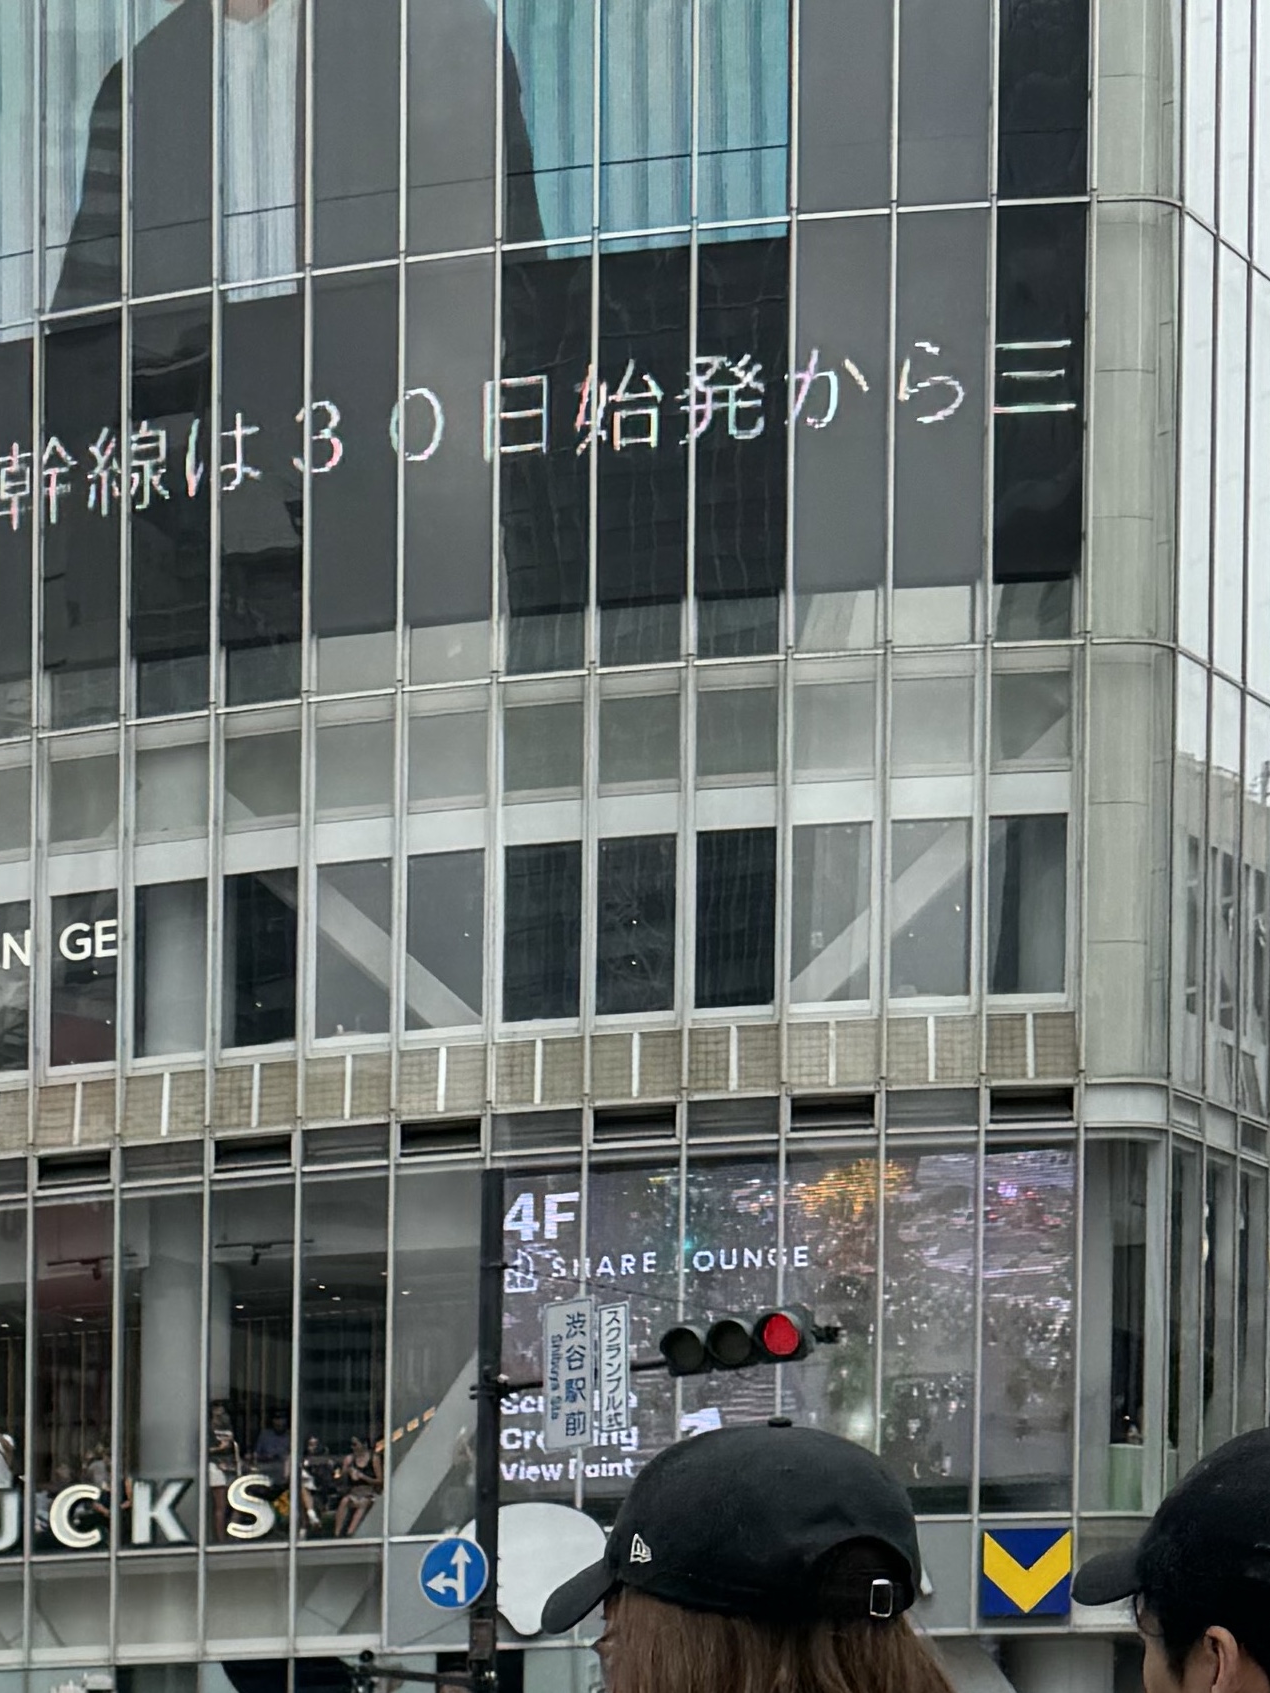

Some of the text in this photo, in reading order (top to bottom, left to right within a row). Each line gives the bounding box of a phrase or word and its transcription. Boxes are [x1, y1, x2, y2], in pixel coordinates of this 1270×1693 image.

[503, 1191, 580, 1242] 4F
[564, 1311, 587, 1437] 渋谷駅前
[500, 1459, 563, 1482] View
